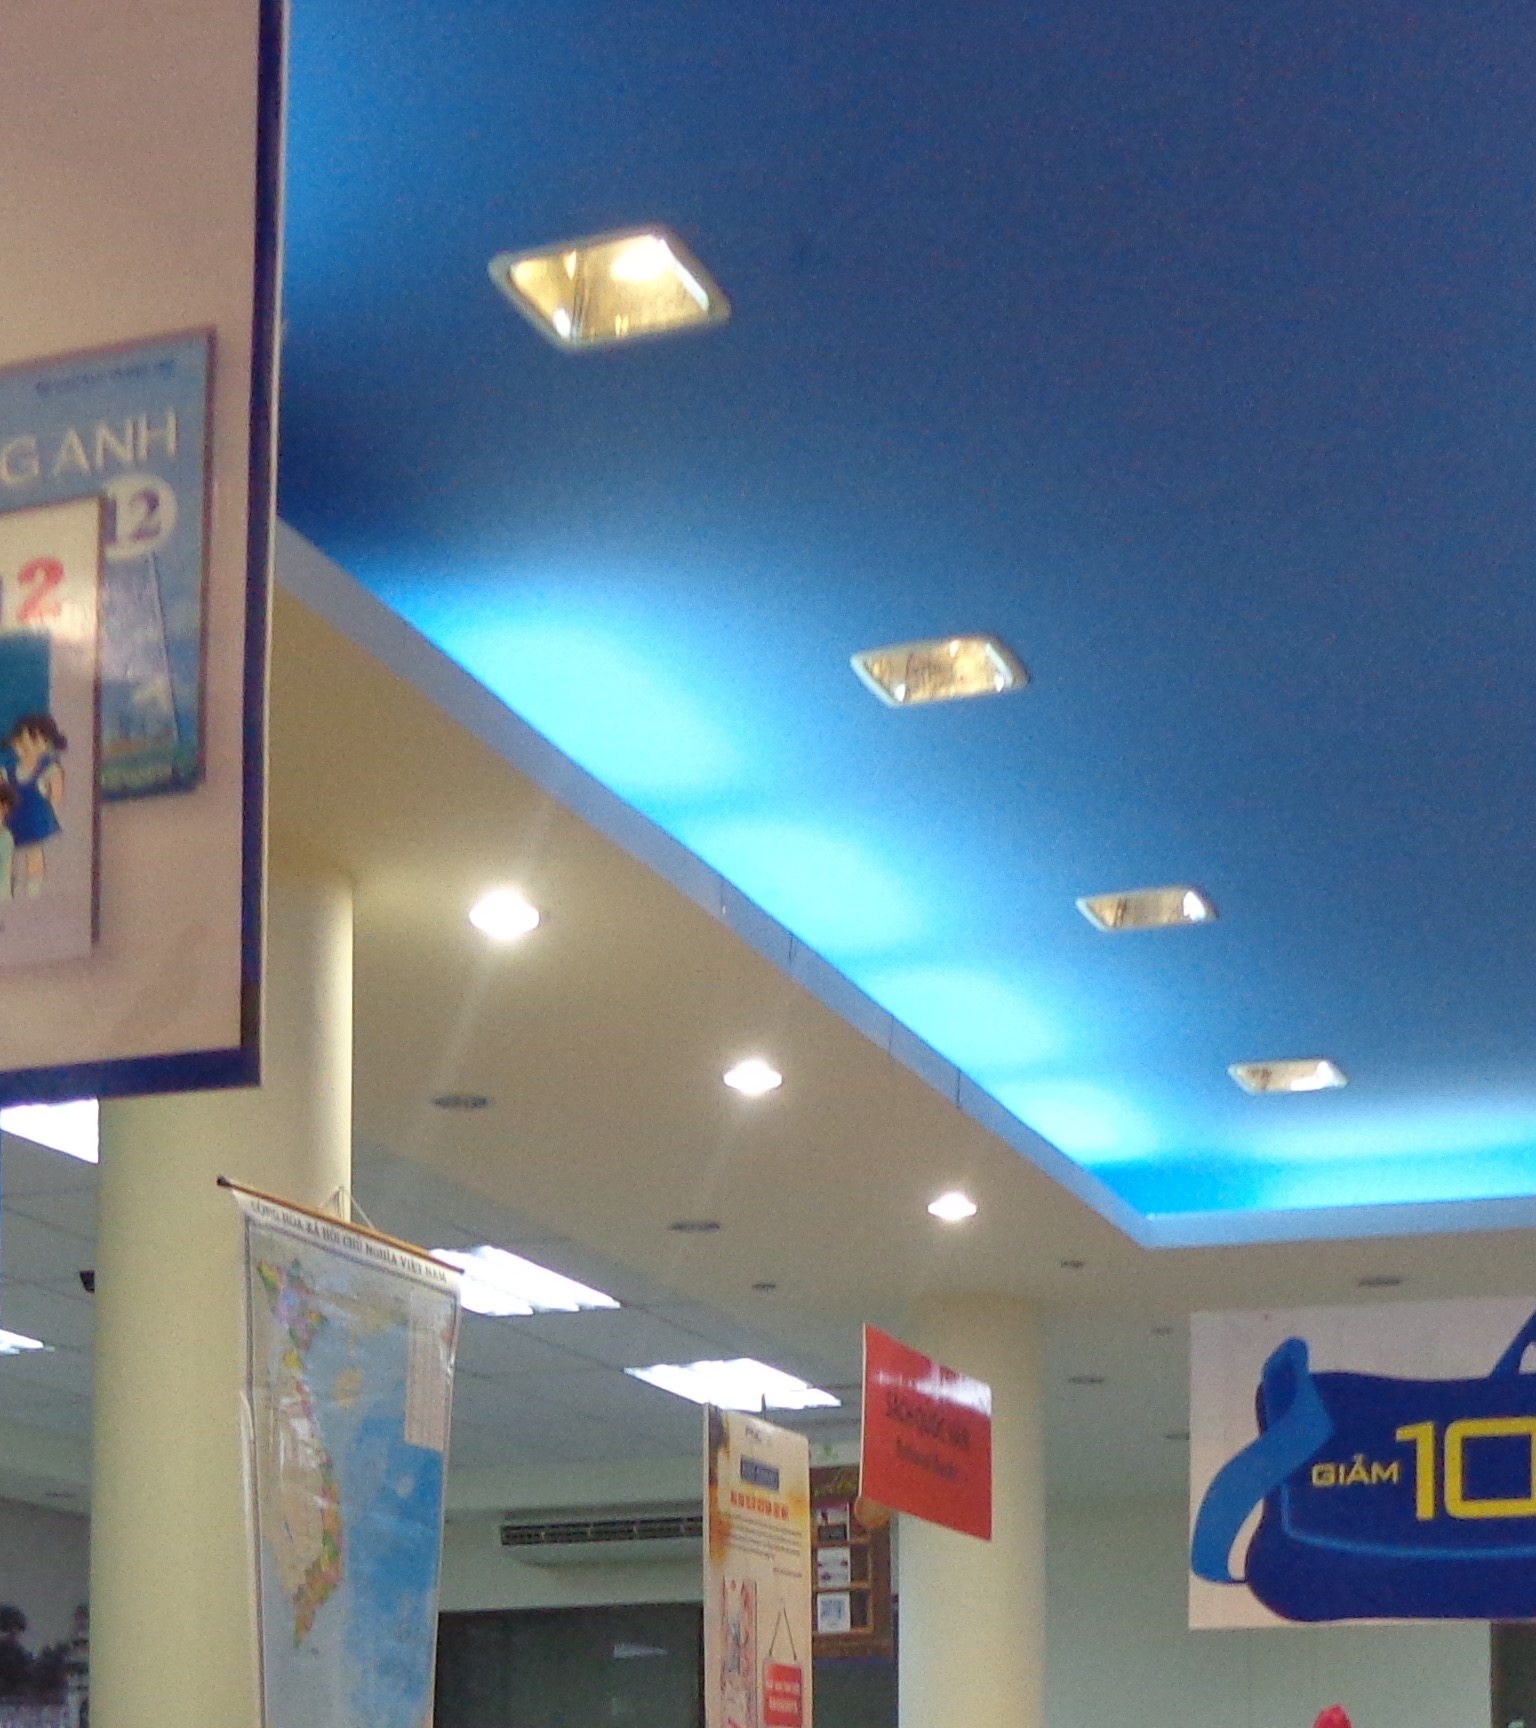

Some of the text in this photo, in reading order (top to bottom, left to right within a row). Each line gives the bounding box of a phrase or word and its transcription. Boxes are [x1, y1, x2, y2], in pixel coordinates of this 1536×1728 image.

[51, 407, 180, 479] ANH
[16, 555, 66, 626] 2
[1311, 1452, 1400, 1488] GIẢM
